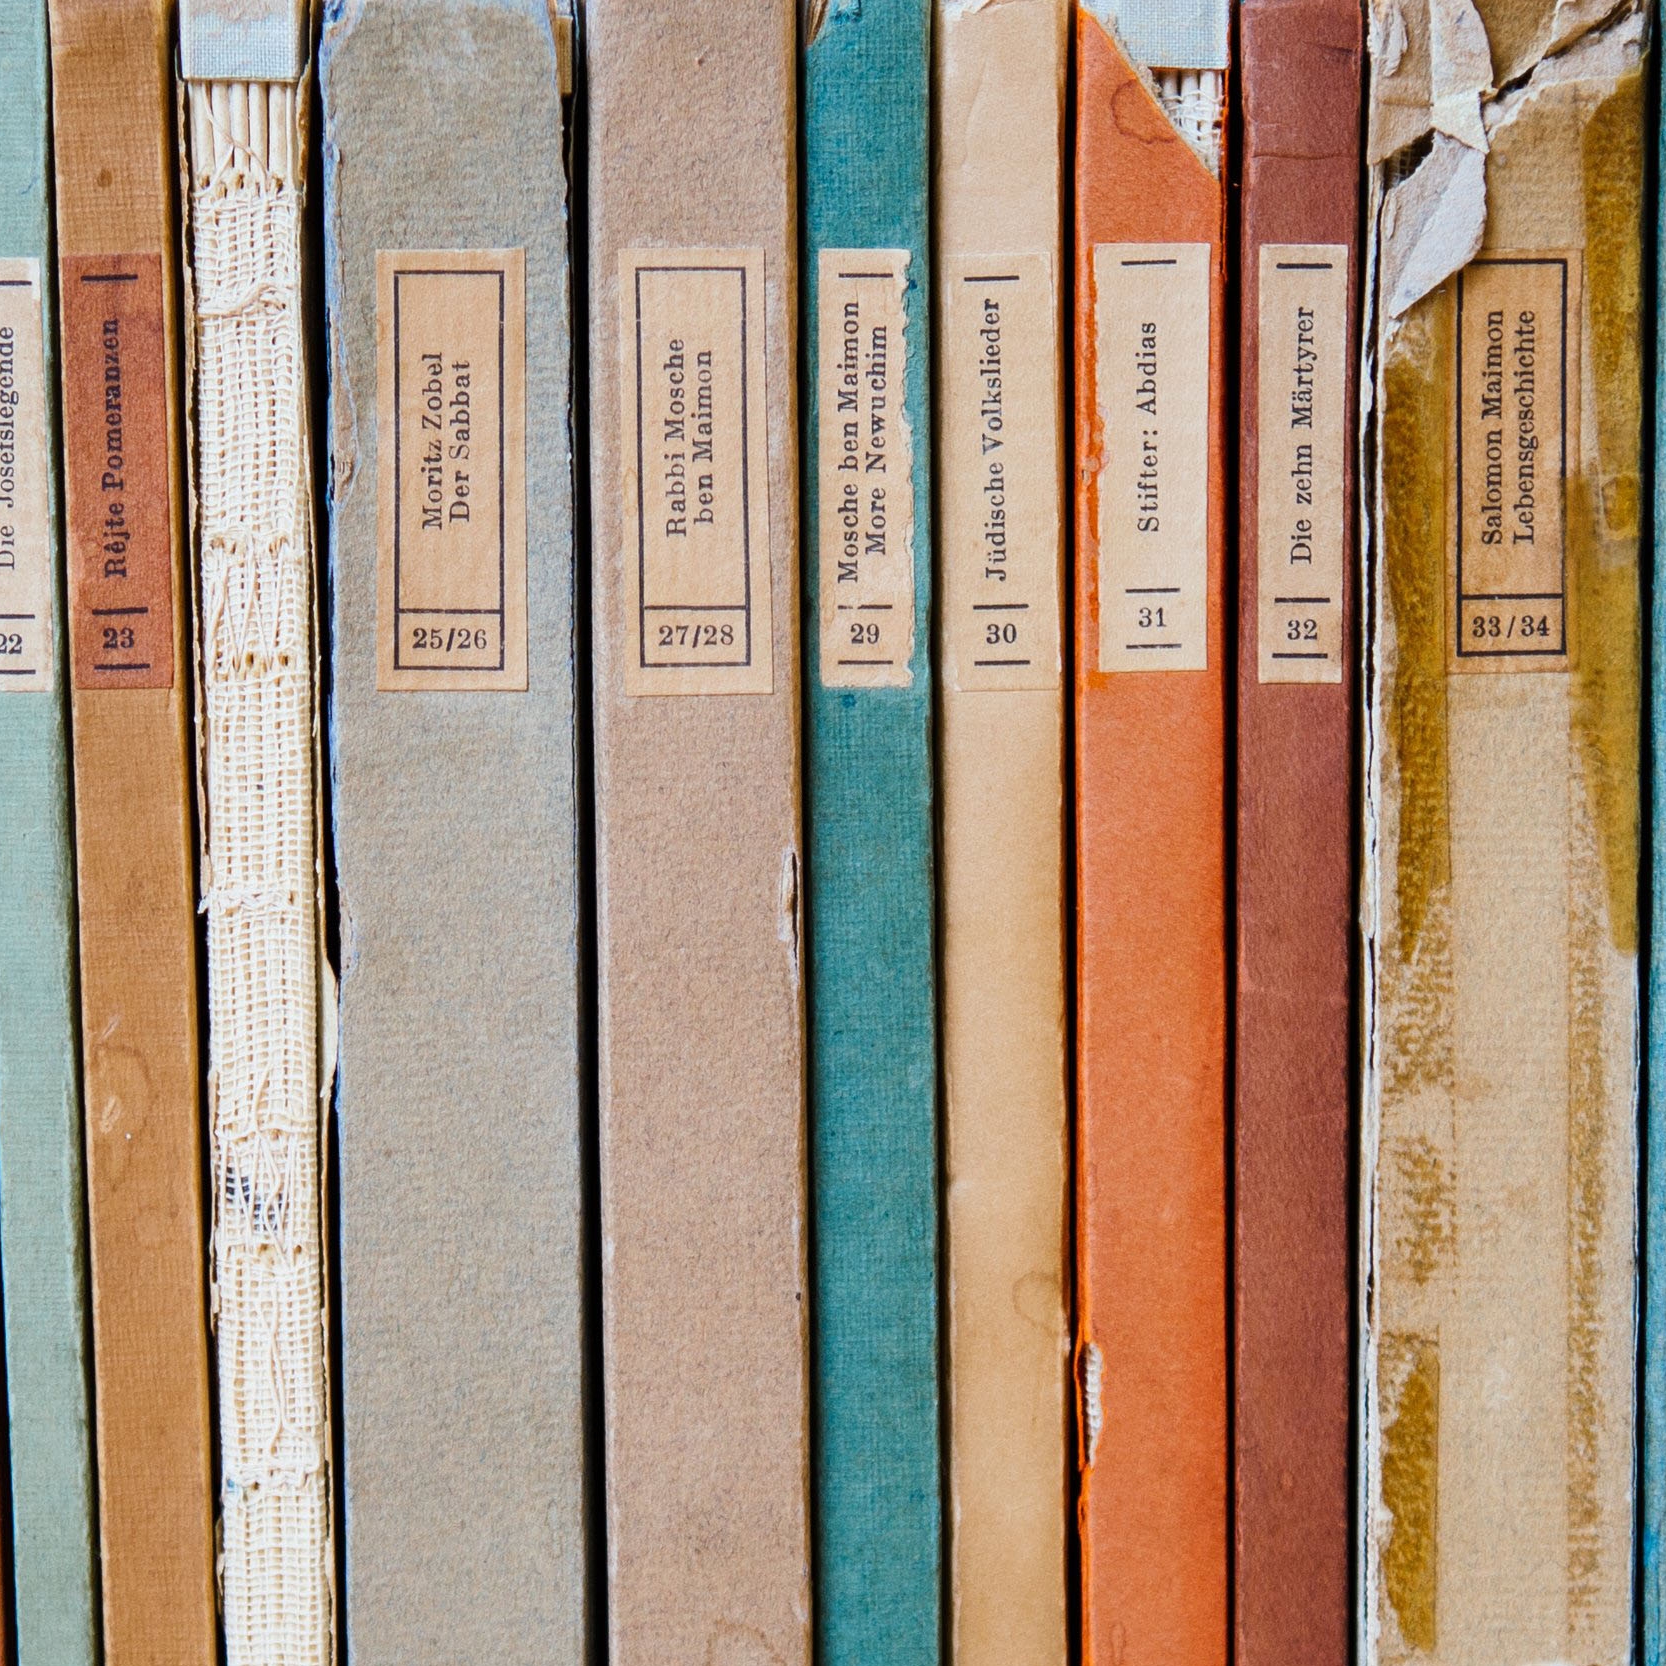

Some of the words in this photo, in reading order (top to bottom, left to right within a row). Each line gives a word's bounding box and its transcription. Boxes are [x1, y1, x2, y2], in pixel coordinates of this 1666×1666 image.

[422, 352, 442, 430] Zobel
[663, 339, 685, 442] Mosche
[837, 302, 859, 412] Maimon
[865, 326, 886, 473] Newuchim
[979, 298, 1003, 455] Volkslieder
[1135, 323, 1156, 415] Abdias
[1291, 307, 1317, 429] Märtyrer
[1481, 310, 1503, 420] Maimon
[449, 361, 470, 459] Sabbat
[691, 350, 712, 462] Maimon
[838, 422, 858, 471] ben
[1513, 311, 1539, 545] Lebensgeschichte
[421, 440, 442, 530] Moritz
[449, 470, 469, 523] Der
[664, 452, 686, 537] Rabbi
[694, 474, 713, 524] ben
[1137, 430, 1159, 531] Stifter:
[1291, 444, 1312, 504] zehn
[1481, 429, 1503, 544] Salomon
[838, 484, 858, 583] Mosche
[865, 488, 886, 555] More
[984, 463, 1006, 581] Jüdische
[1291, 520, 1312, 564] Die
[412, 628, 486, 652] 25/26
[659, 625, 734, 648] 27/28
[851, 624, 879, 644] 29
[986, 624, 1016, 644] 30
[1139, 607, 1166, 627] 31
[1288, 619, 1317, 640] 32
[1472, 615, 1549, 638] 33/34
